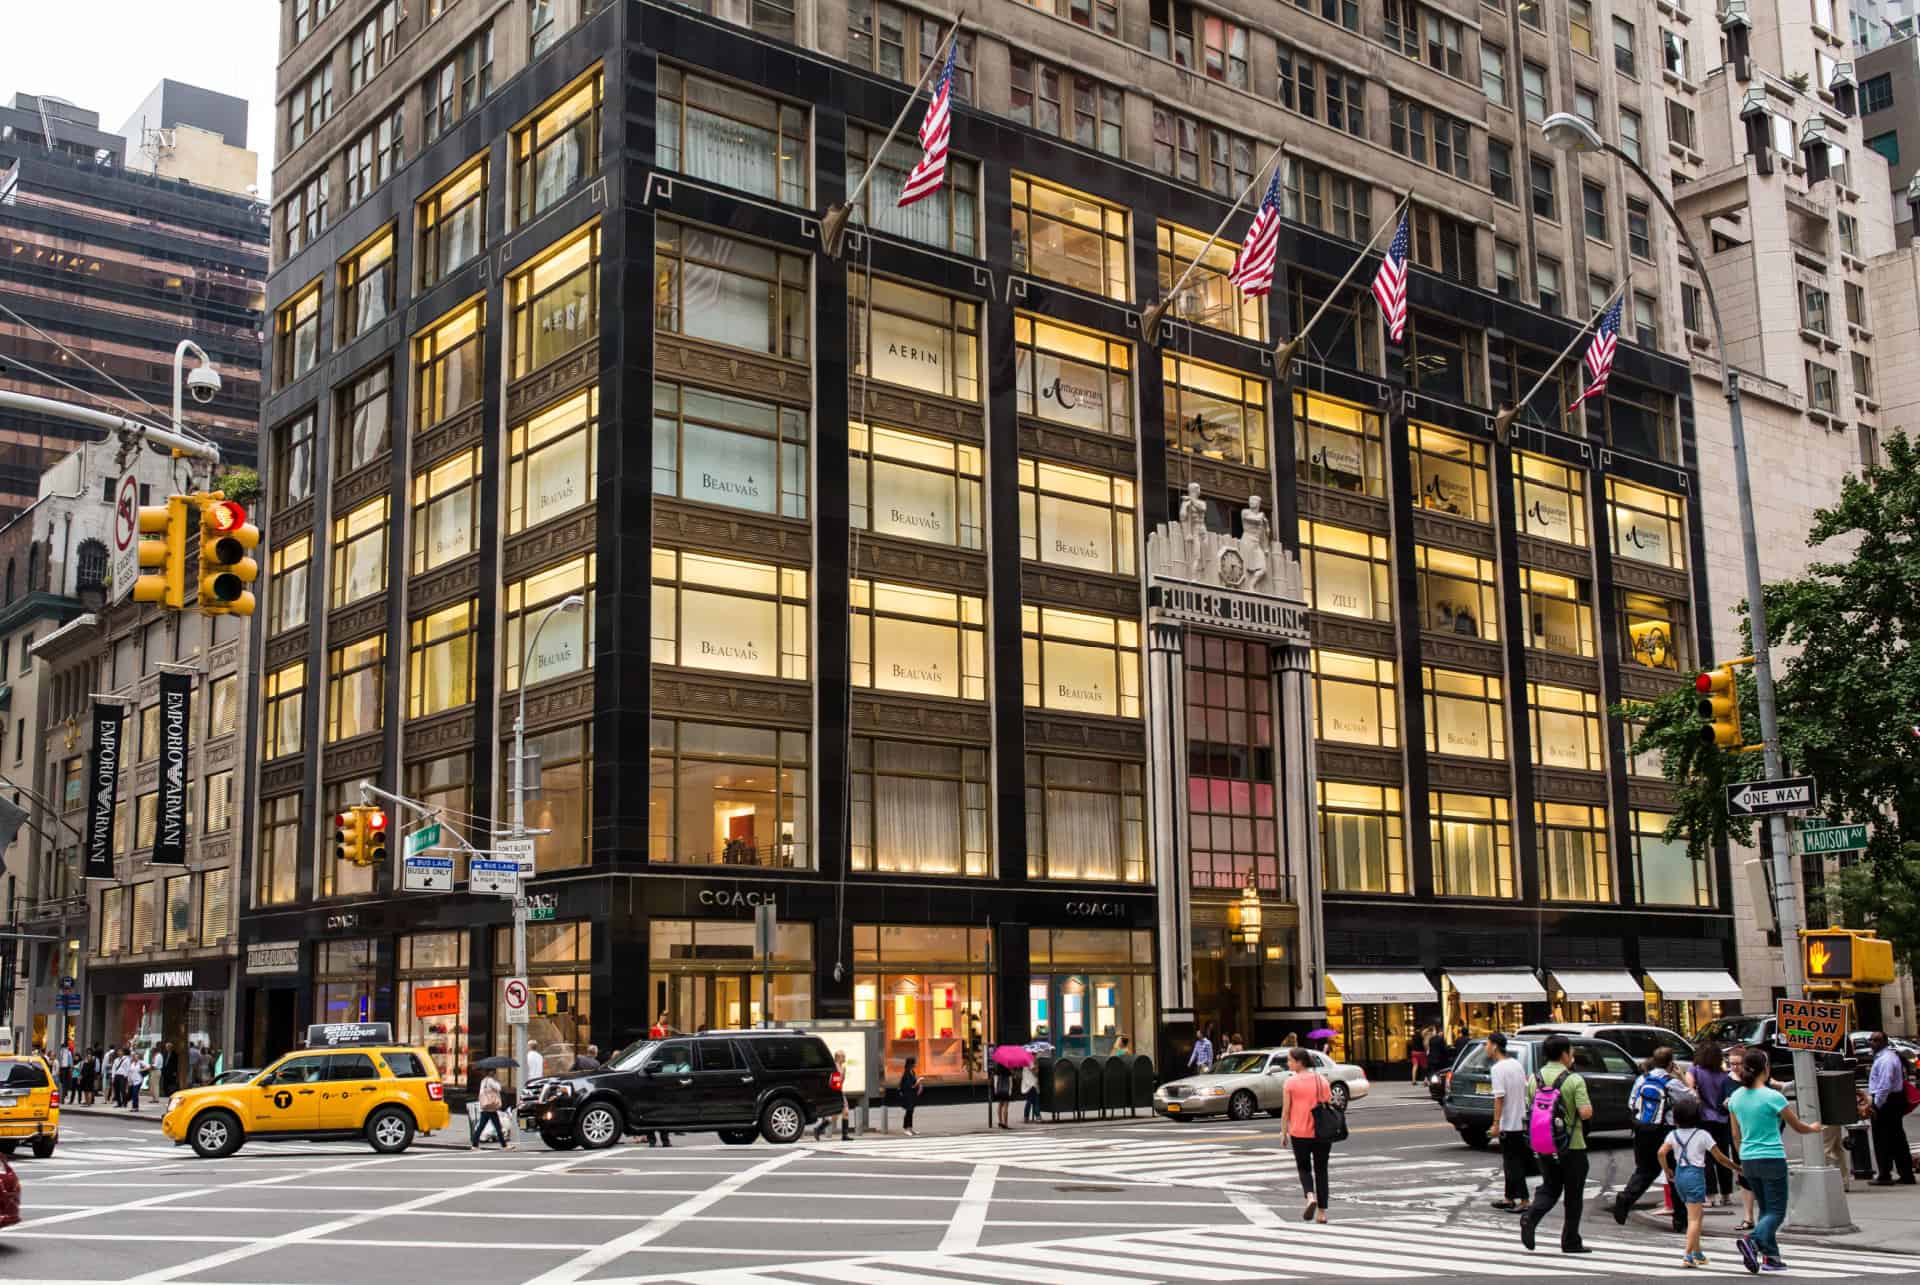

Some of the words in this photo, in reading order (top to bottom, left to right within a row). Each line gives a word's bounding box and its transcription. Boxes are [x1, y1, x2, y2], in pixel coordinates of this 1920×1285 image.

[889, 343, 937, 365] AERIN
[1161, 588, 1222, 617] FULLER
[1231, 600, 1304, 631] BUILDING
[167, 692, 184, 764] EMPORIO
[99, 720, 116, 787] EMPORIO
[1743, 791, 1769, 805] ONE
[1776, 788, 1802, 801] WAY
[163, 784, 183, 846] ARMANI
[90, 806, 112, 863] ARMANI
[1806, 831, 1849, 851] MADISON
[1851, 828, 1863, 838] AV
[408, 867, 430, 875] BUSES
[432, 868, 450, 876] ONLY
[416, 859, 430, 867] BUS
[698, 889, 776, 907] COACH
[1066, 902, 1125, 917] COACH
[1783, 1004, 1841, 1019] RAISE
[1785, 1018, 1837, 1034] PLOW
[1789, 1035, 1833, 1049] AHEAD
